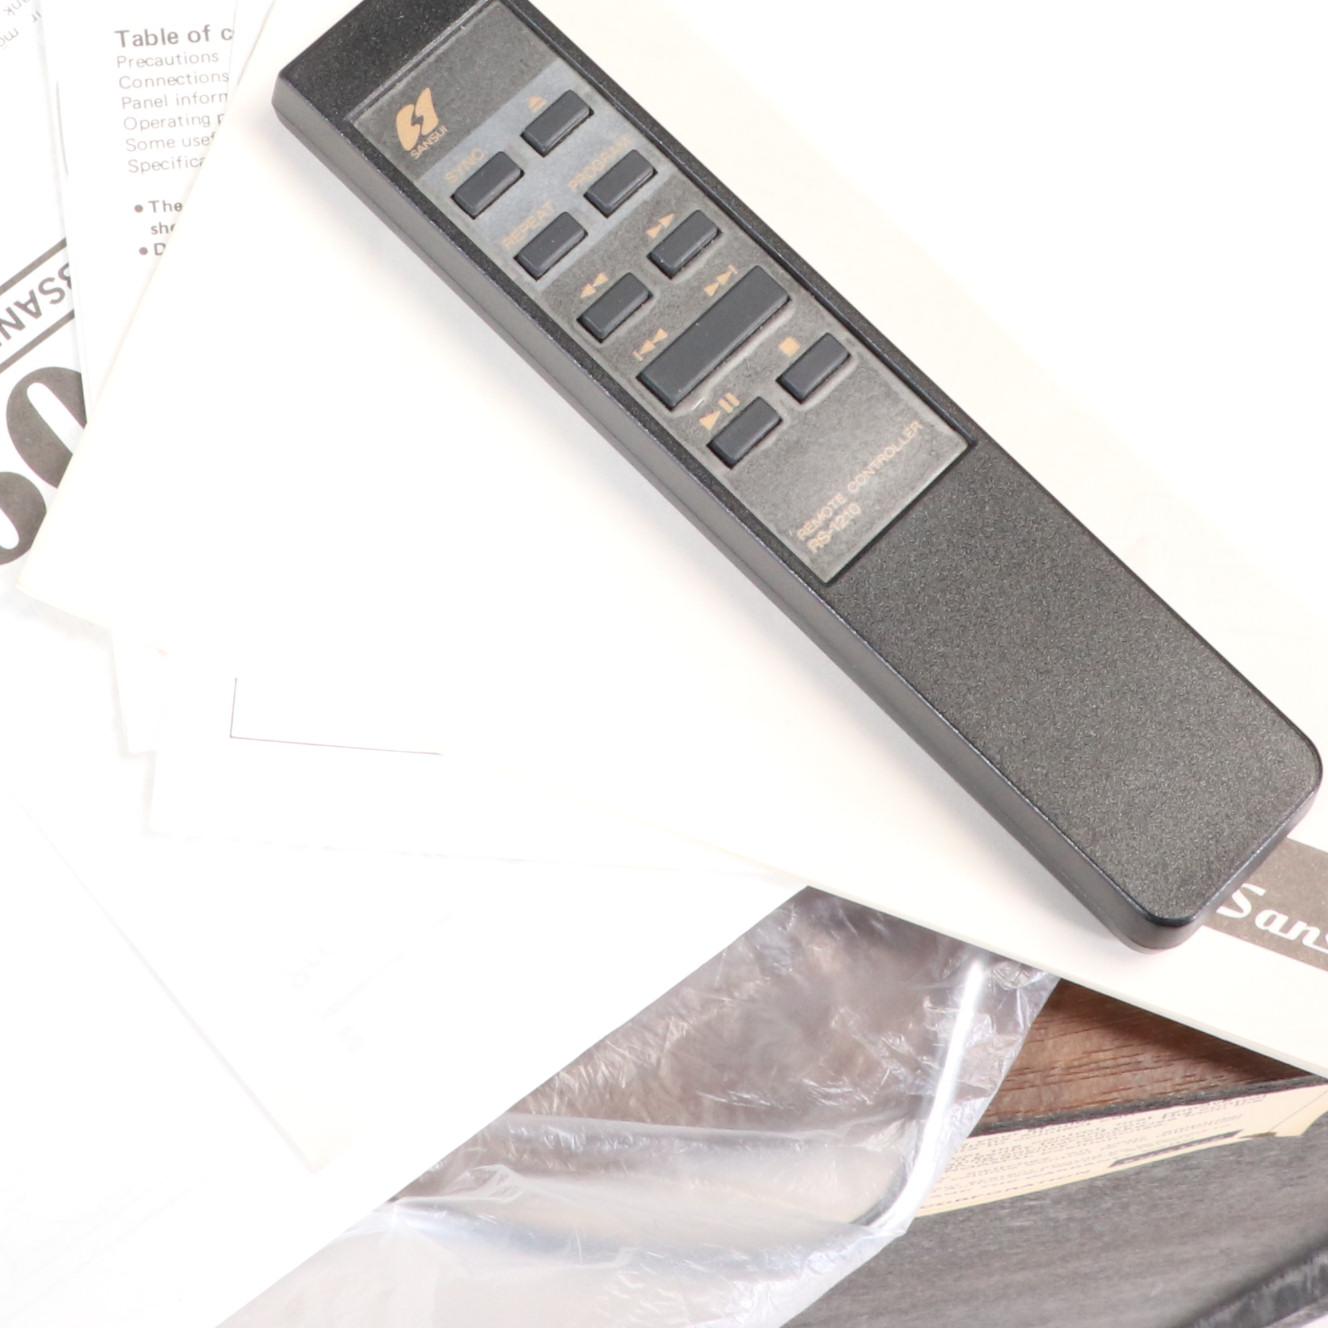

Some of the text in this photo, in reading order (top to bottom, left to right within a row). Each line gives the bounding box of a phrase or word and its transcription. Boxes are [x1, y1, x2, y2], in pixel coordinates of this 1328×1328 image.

[113, 22, 210, 48] Table of
[115, 51, 220, 69] Precautions
[117, 71, 230, 90] Connections
[120, 92, 168, 110] Panel
[122, 113, 211, 132] Operating
[124, 136, 176, 153] Some
[410, 125, 448, 160] SANSUI
